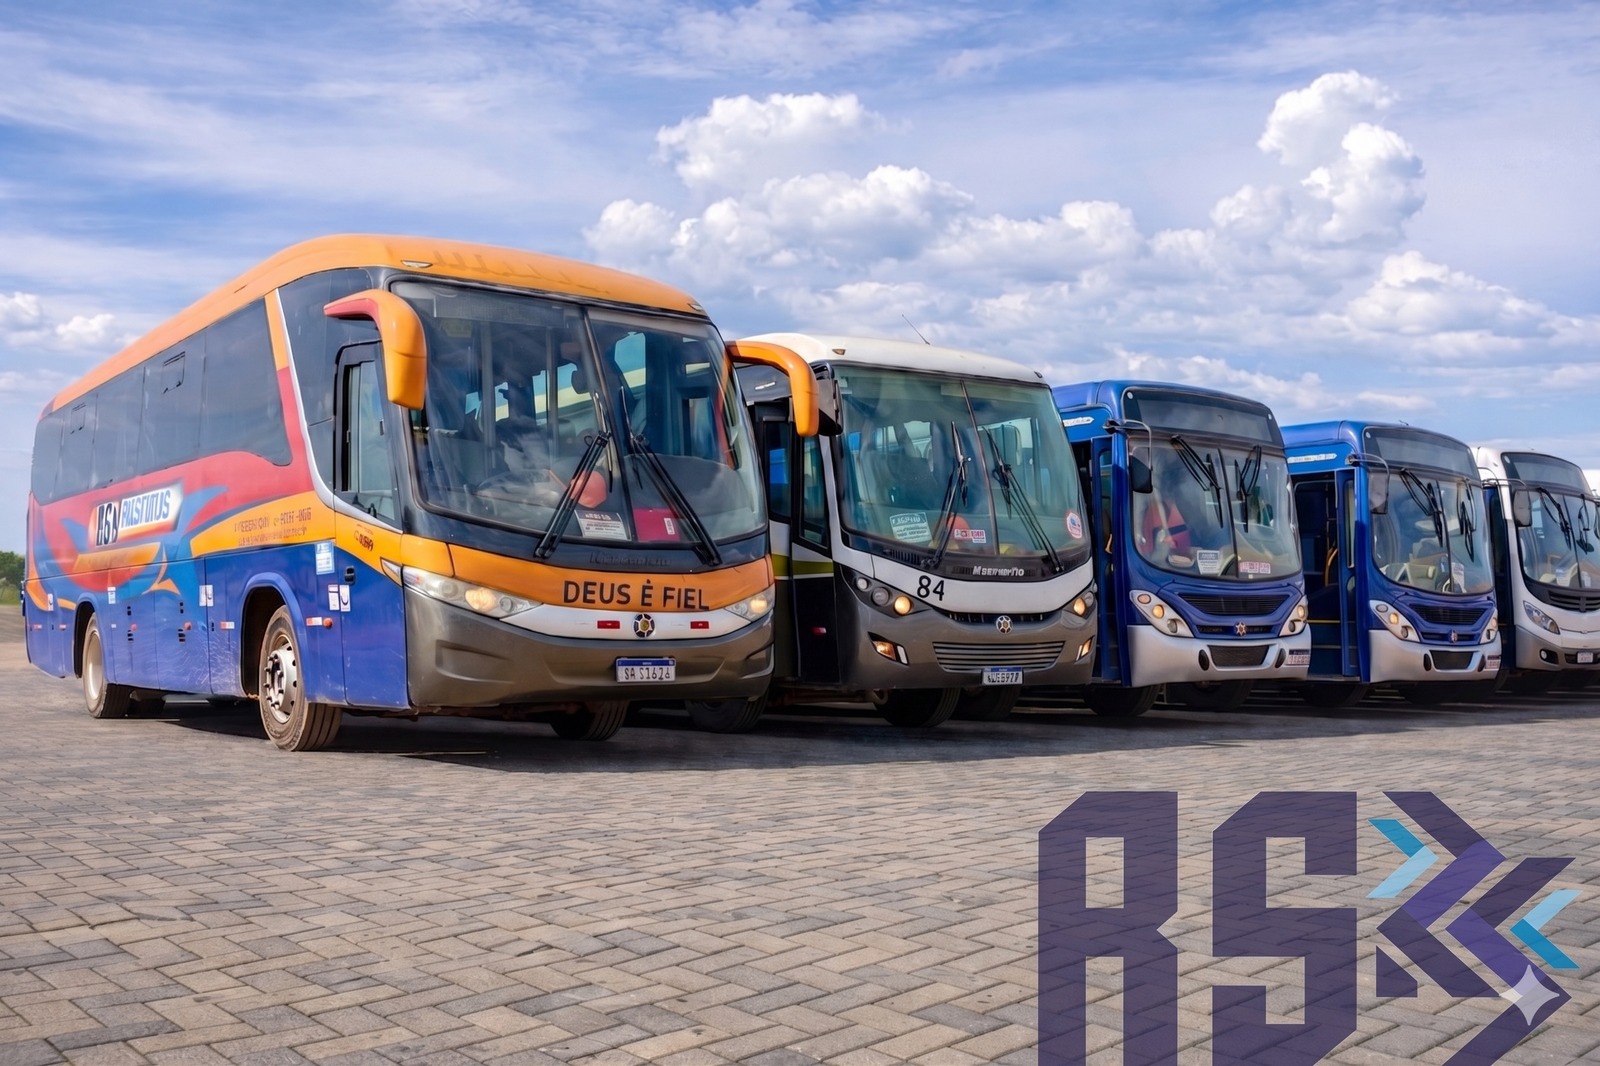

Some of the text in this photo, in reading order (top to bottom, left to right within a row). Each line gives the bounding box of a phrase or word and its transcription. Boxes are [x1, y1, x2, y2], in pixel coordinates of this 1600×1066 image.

[563, 580, 631, 605] DEUS
[662, 586, 710, 610] FIEL
[916, 575, 945, 601] 84
